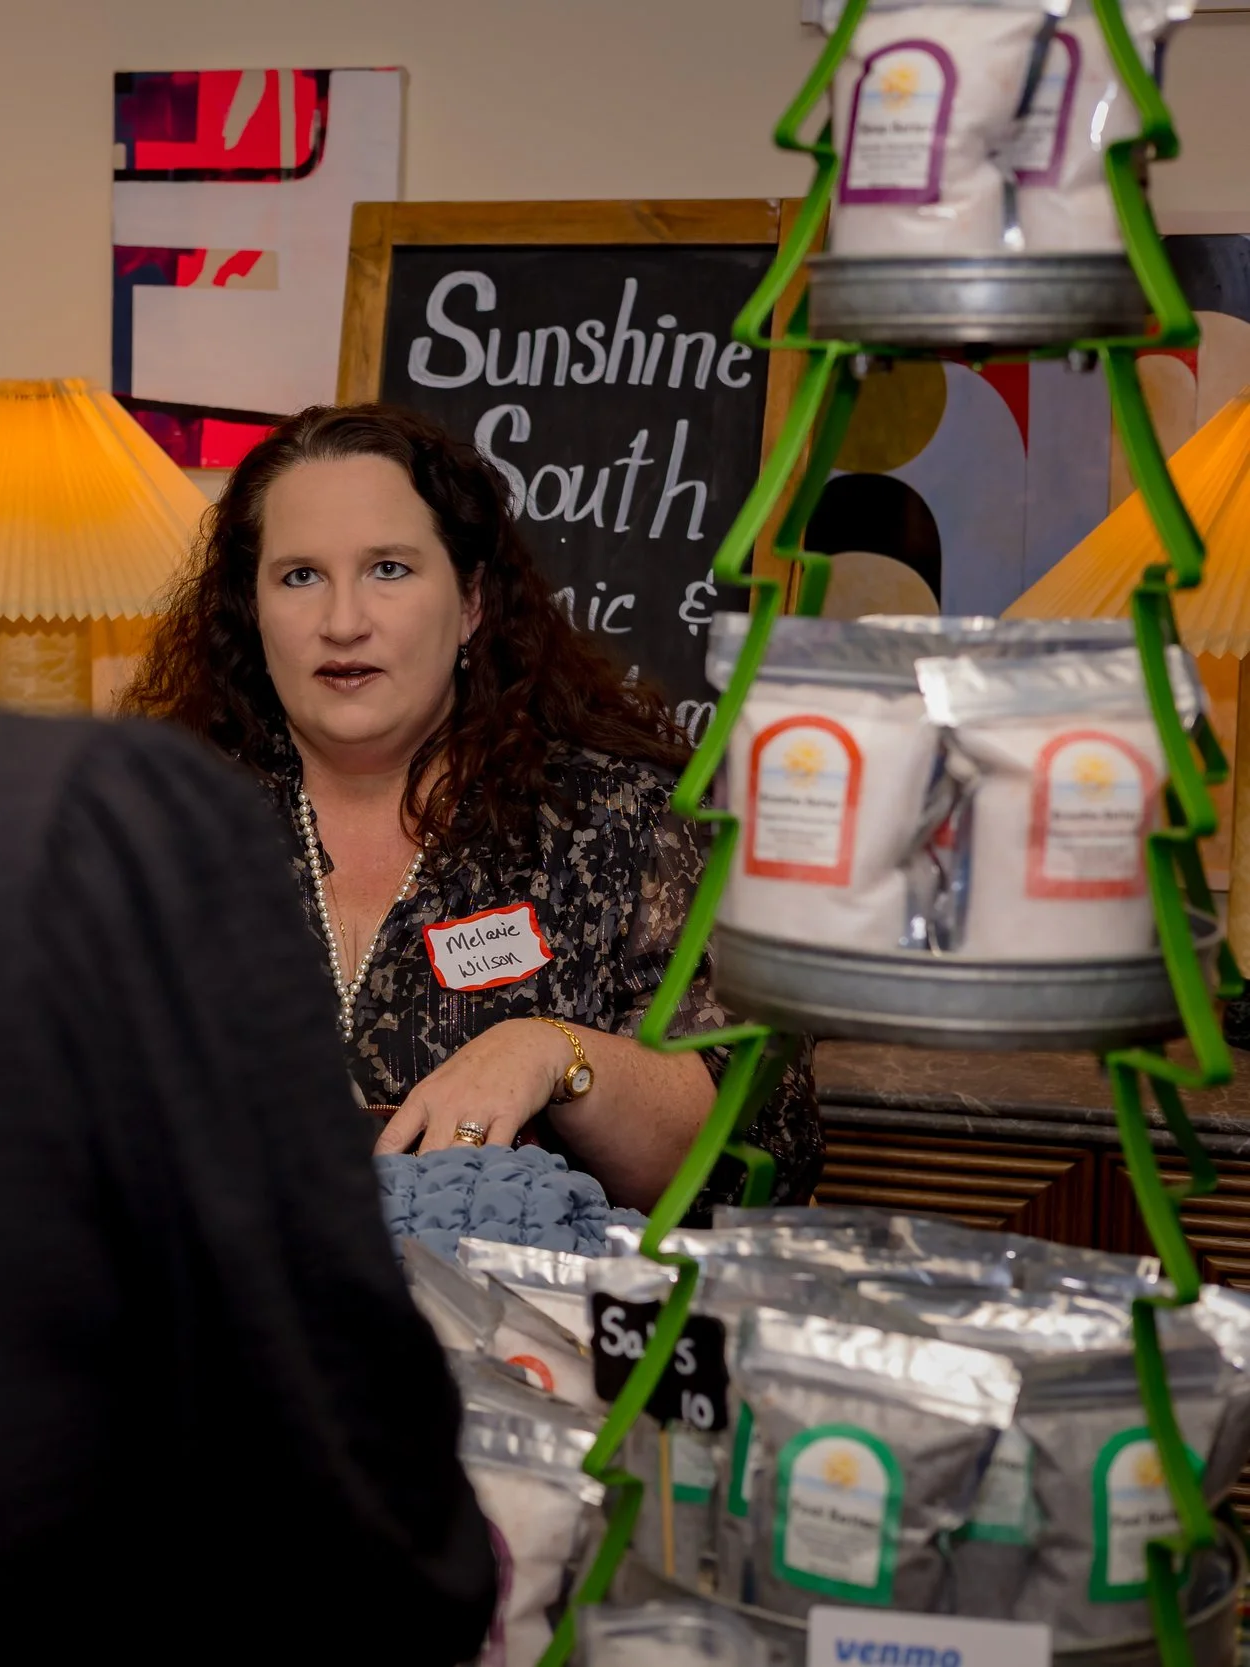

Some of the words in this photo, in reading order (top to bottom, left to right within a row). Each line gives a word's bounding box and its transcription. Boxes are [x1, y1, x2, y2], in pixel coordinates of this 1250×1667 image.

[407, 270, 752, 390] Sunshine
[473, 403, 708, 541] South
[446, 921, 520, 954] Melanie
[458, 952, 522, 978] Wilson
[600, 1305, 697, 1376] Sas
[681, 1389, 715, 1430] 10
[835, 1636, 963, 1667] venmo
